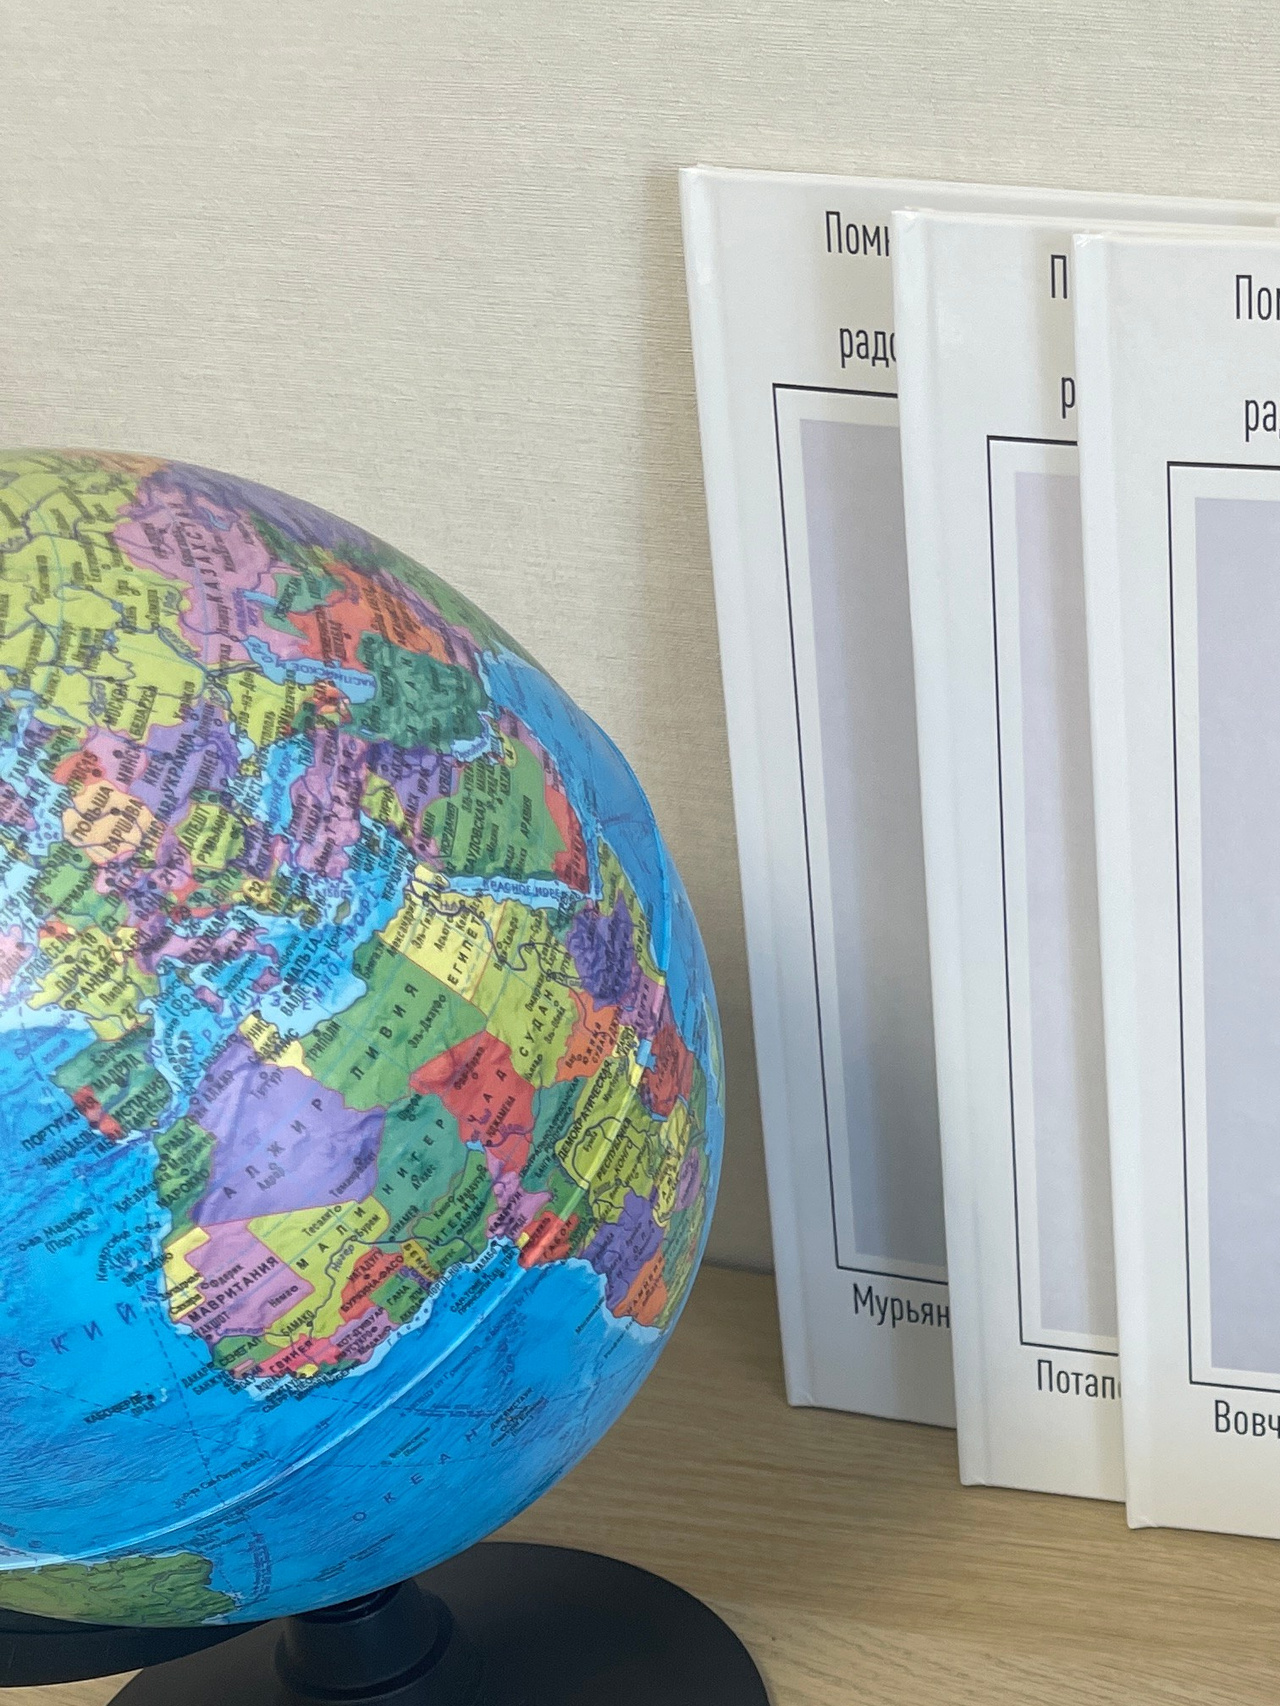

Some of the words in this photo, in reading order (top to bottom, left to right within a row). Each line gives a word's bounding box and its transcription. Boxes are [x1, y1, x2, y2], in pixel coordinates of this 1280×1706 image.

[103, 682, 128, 726] МОСКВА
[129, 686, 158, 740] БЕЛАРУСЬ
[160, 732, 194, 795] УКРАИНА
[72, 786, 114, 840] ПОЛЬША
[324, 749, 356, 836] ТУРЦИЯ
[379, 786, 395, 823] СИРИЯ
[102, 799, 144, 853] ВАРШАВА
[197, 809, 230, 864] РУМЫНИЯ
[302, 802, 323, 845] АНКАРА
[464, 799, 488, 874] САУДОВСКАЯ
[250, 880, 262, 898] 32
[482, 879, 532, 895] КРАСНОЕ
[55, 954, 96, 993] ПАРИЖ
[284, 936, 319, 986] МАЛЬТА
[447, 914, 483, 985] ЕГИПЕТ
[64, 956, 119, 1011] ФРАНЦИЯ
[280, 968, 321, 1017] ВАЛЛЕТТА
[305, 1020, 342, 1062] ТРИПОЛИ
[350, 982, 419, 1081] ЛИВИЯ
[519, 989, 555, 1058] СУДАН
[92, 1053, 143, 1091] МАДРИД
[467, 1069, 507, 1123] ЧАД
[112, 1073, 167, 1124] ИСПАНИЯ
[486, 1096, 516, 1138] НДЖАМЕНА
[557, 1058, 612, 1163] ДЕМОКРАТИЧЕСКАЯ
[222, 1098, 324, 1199] АЛЖИР
[382, 1118, 445, 1196] НИГЕР
[596, 1117, 632, 1182] РЕСПУБЛИКА
[613, 1141, 634, 1175] КОНГО
[159, 1168, 209, 1208] МАРОККО
[489, 1191, 523, 1234] КАМЕРУН
[296, 1207, 366, 1271] МАЛИ
[391, 1204, 420, 1234] НИАМЕЙ
[426, 1193, 478, 1254] НИГЕРИЯ
[188, 1255, 280, 1323] МАВРИТАНИЯ
[341, 1254, 404, 1313] БУРКИНА-ФАСО
[386, 1284, 410, 1306] ГАНА
[281, 1309, 317, 1337] БАМАКО
[219, 1336, 261, 1367] СЕНЕГАЛ
[269, 1339, 313, 1373] ГВИНЕЯ
